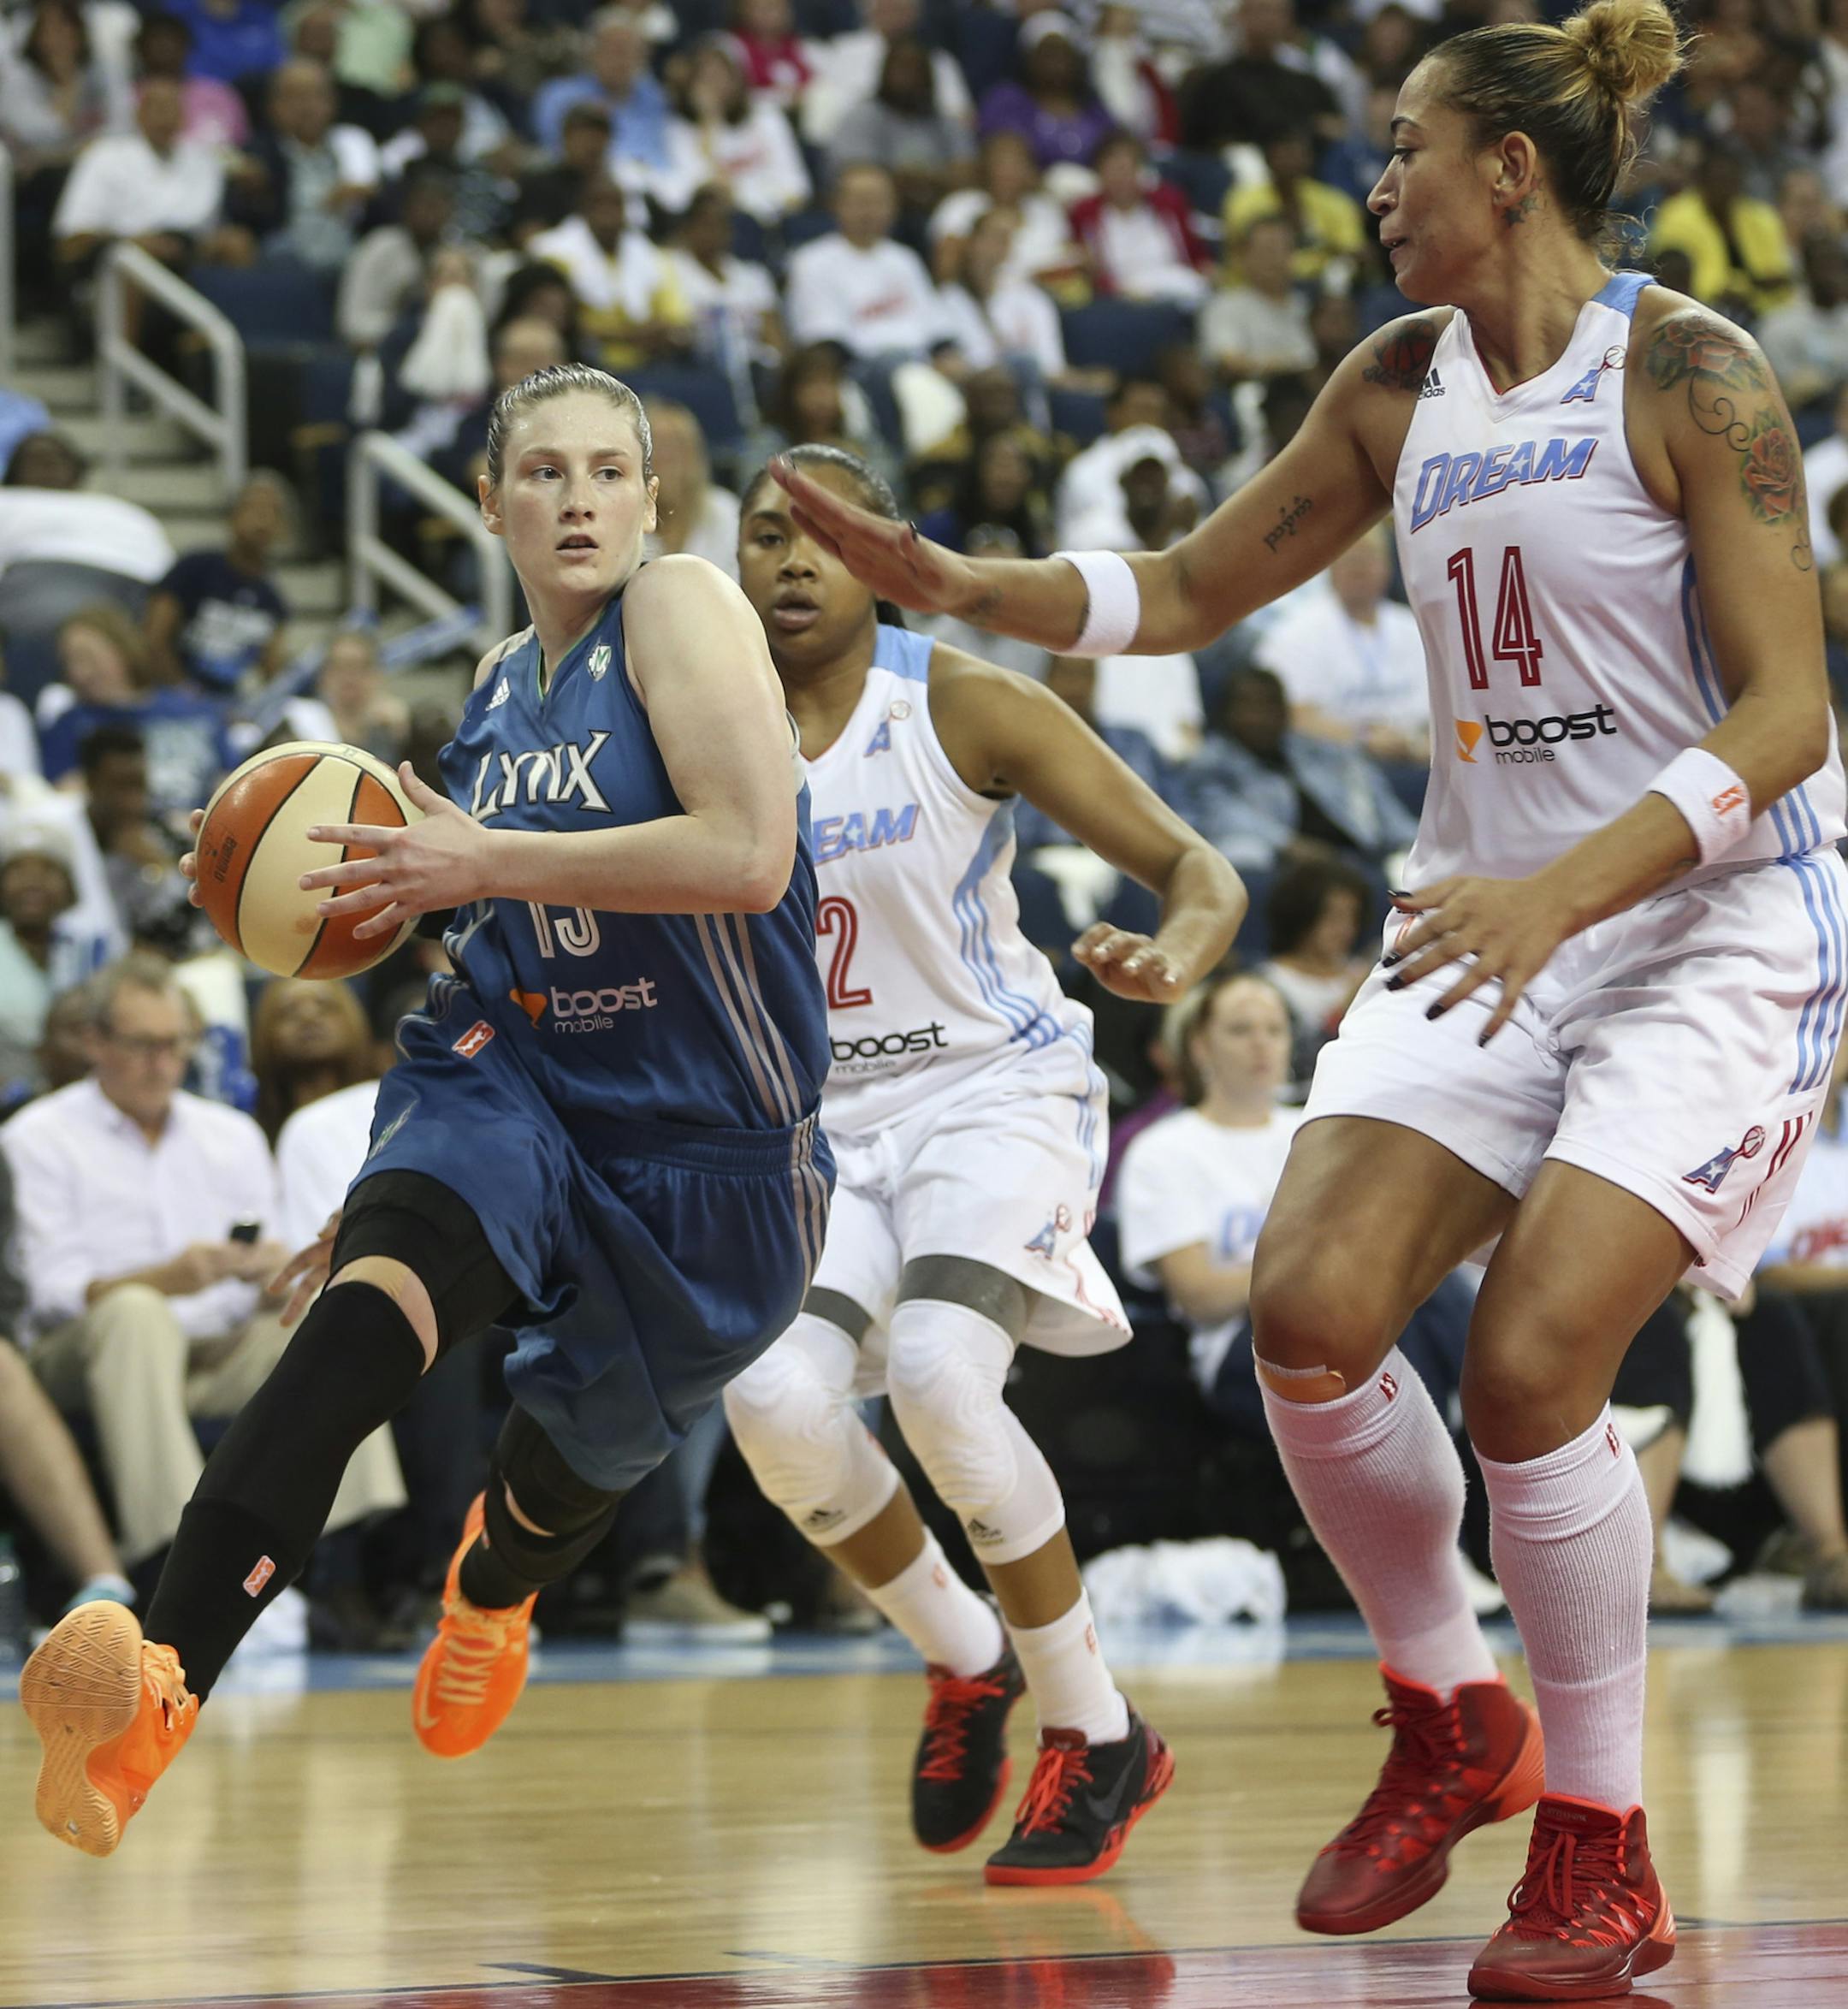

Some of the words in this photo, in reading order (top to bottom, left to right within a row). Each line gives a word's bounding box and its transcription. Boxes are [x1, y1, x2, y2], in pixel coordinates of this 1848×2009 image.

[1411, 437, 1599, 535] DREAM
[1447, 546, 1543, 690] 14
[1484, 703, 1617, 747] boost
[1496, 746, 1556, 764] mobile
[813, 803, 921, 868] EAM
[815, 896, 874, 1010] 2
[550, 976, 658, 1017] boost
[554, 1015, 614, 1034] mobile
[829, 1021, 949, 1061] boost
